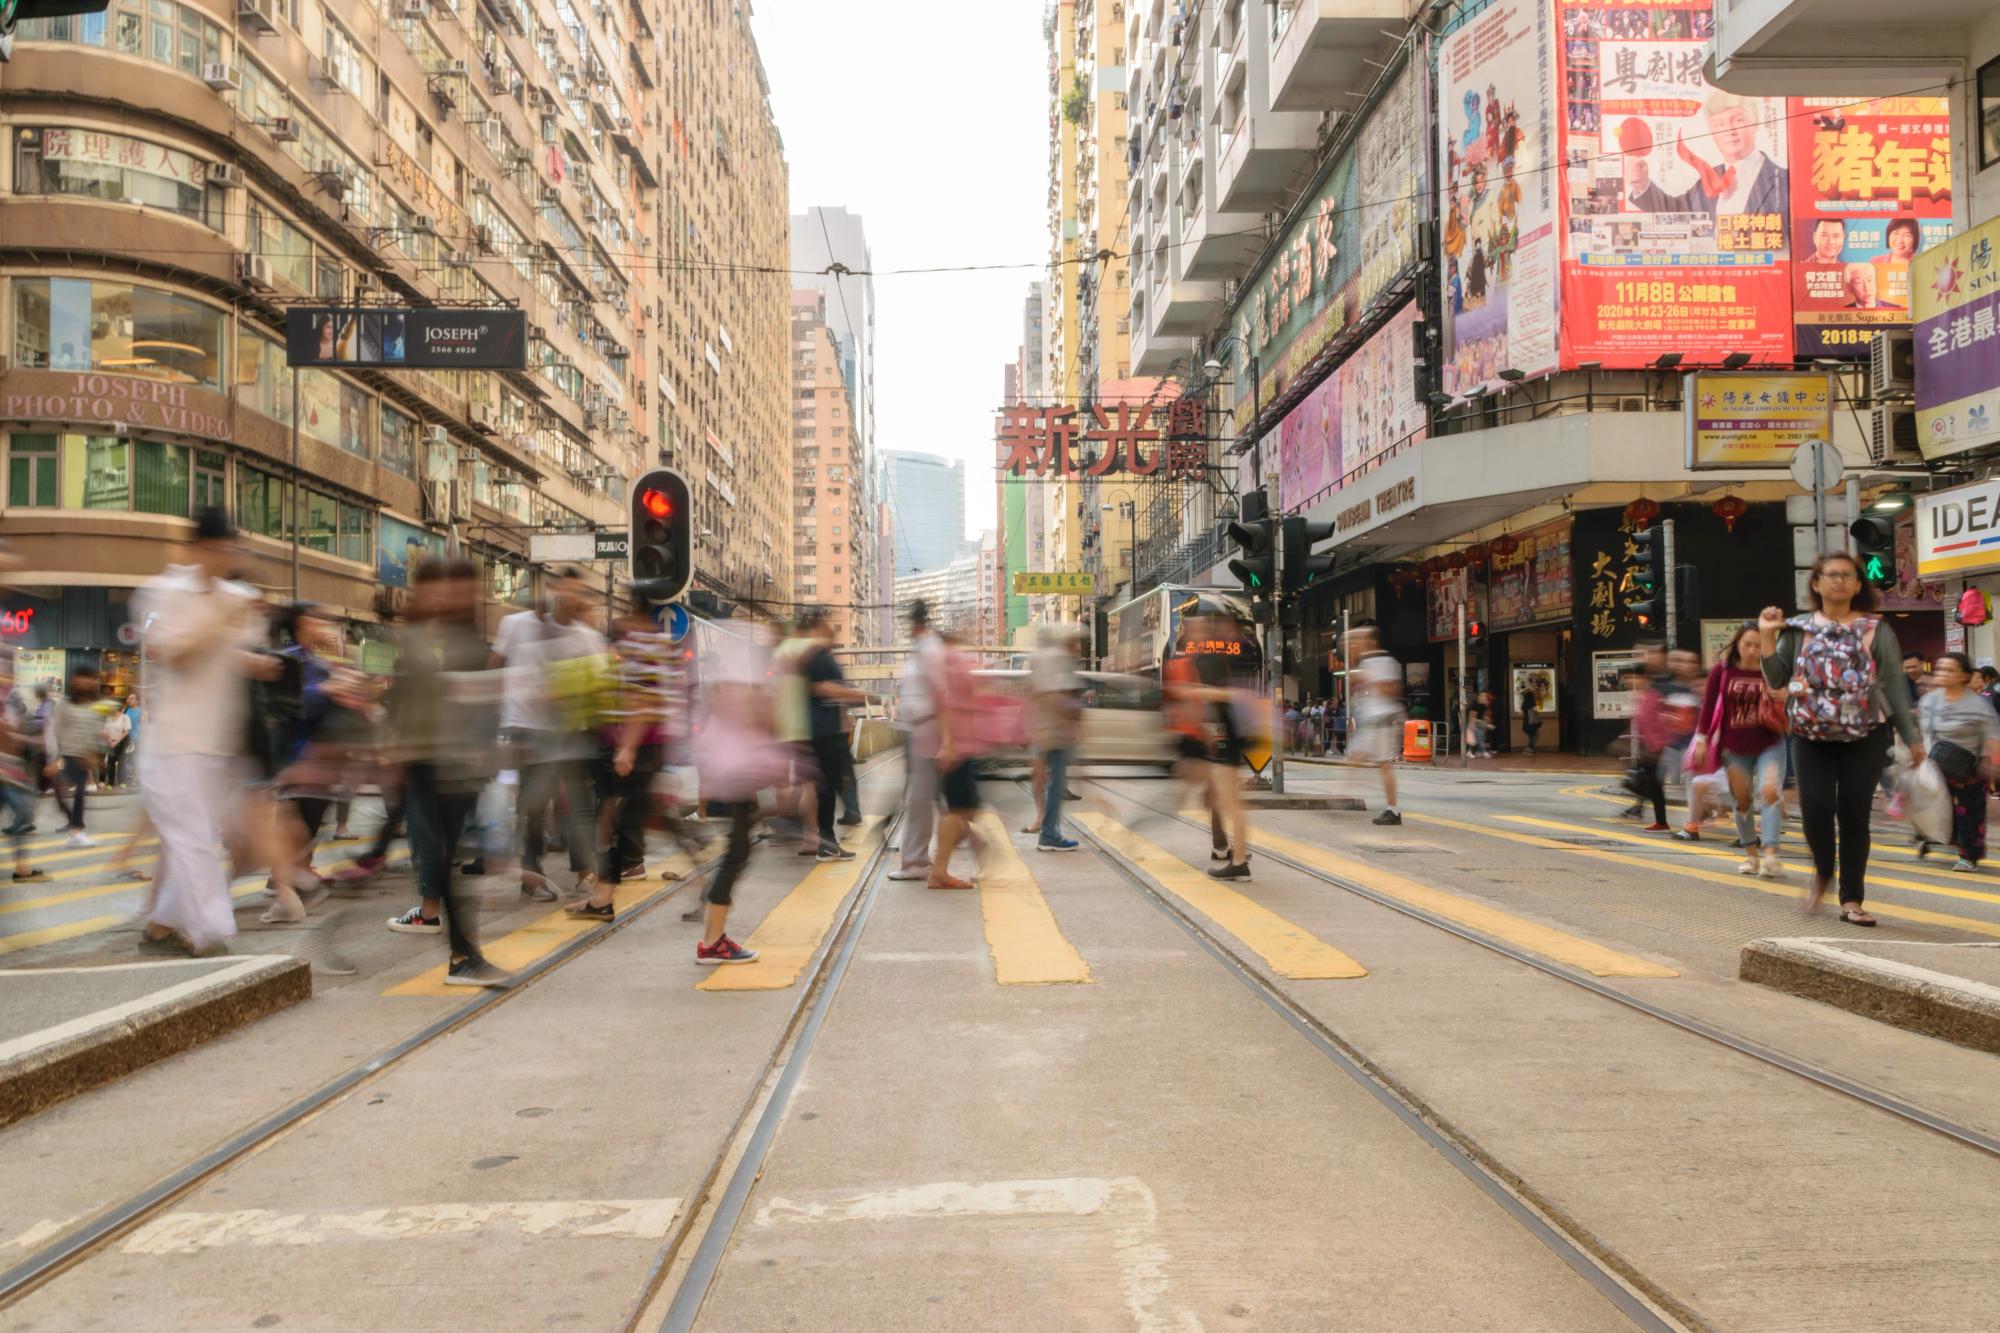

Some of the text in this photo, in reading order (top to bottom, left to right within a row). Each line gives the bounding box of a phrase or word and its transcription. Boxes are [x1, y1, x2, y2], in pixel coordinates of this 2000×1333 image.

[1616, 282, 1675, 303] 11月8日
[72, 374, 187, 408] JOSEPH
[7, 395, 231, 439] PHOTO & VIDEO
[1002, 400, 1160, 477] 新光
[1167, 399, 1208, 480] 戲院
[1375, 476, 1415, 515] THEATRE
[1590, 550, 1617, 638] 大劇場
[1226, 642, 1241, 654] 38
